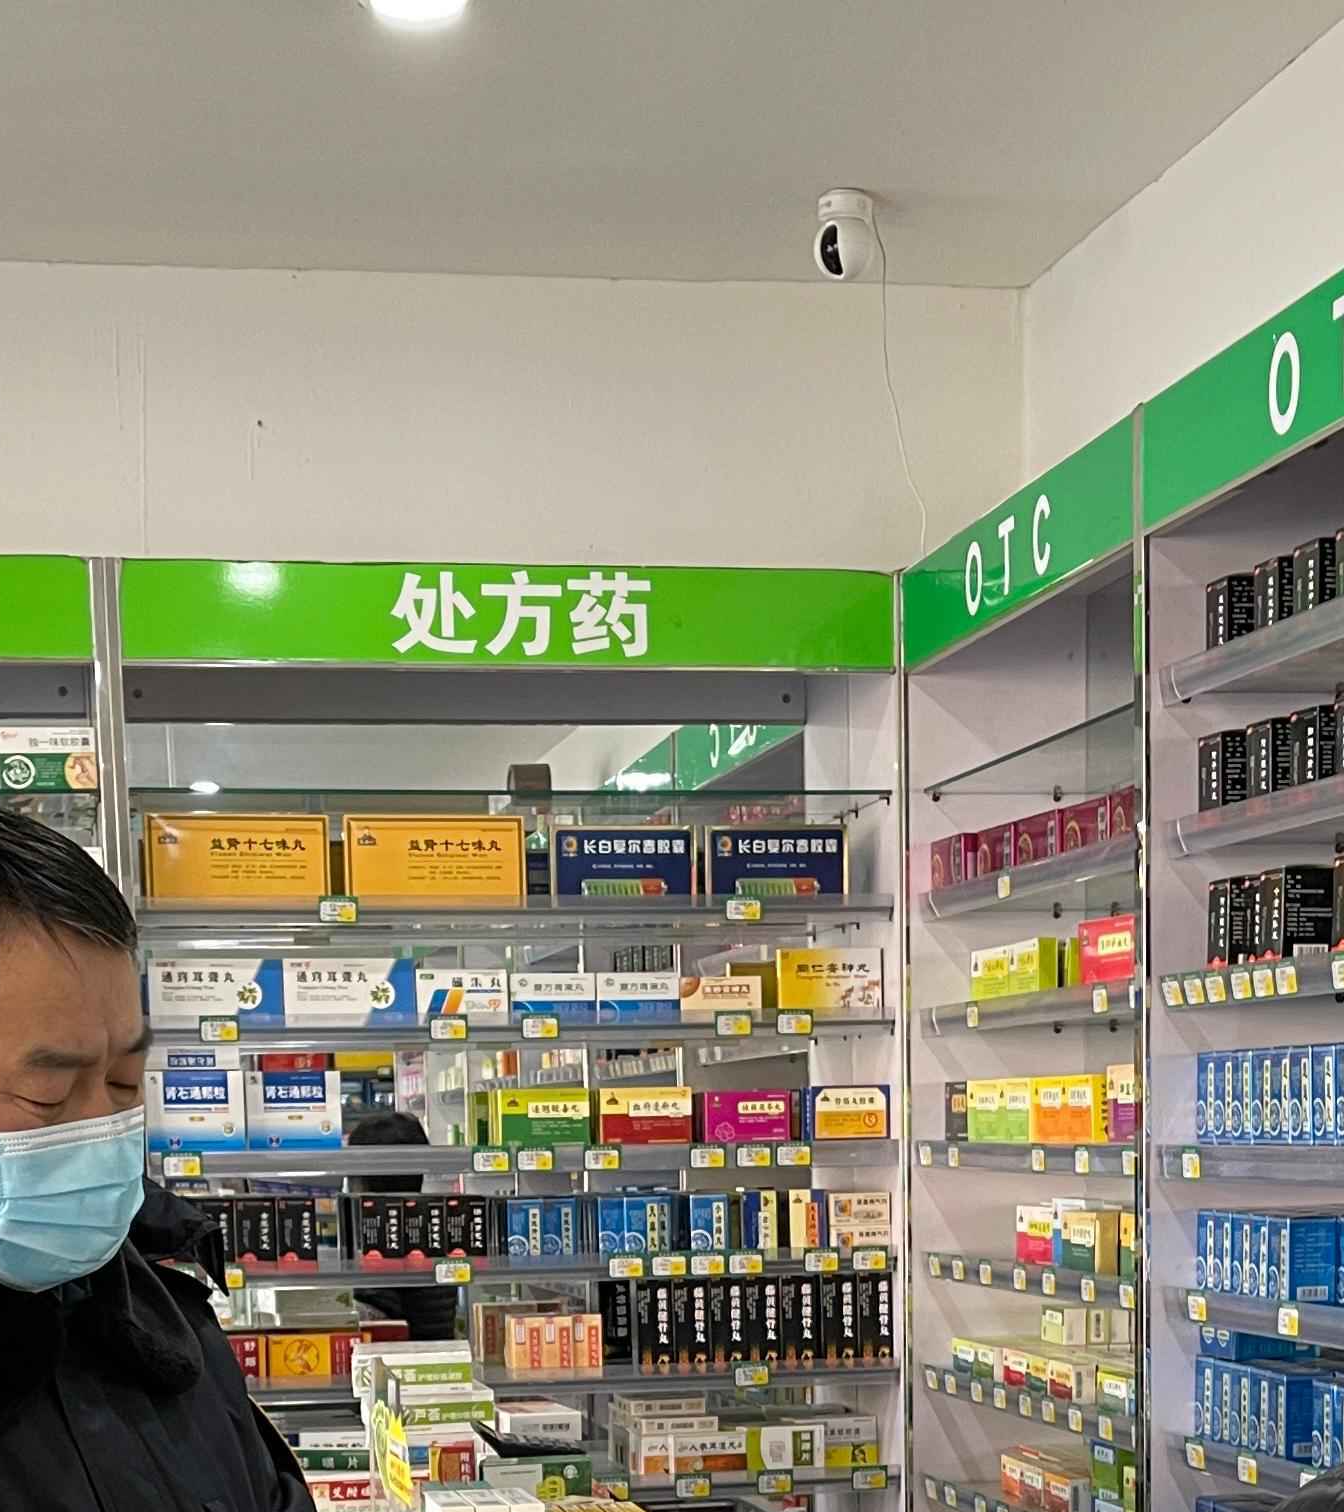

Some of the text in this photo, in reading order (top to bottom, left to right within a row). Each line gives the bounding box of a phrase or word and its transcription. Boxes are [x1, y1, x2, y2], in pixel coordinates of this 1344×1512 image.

[963, 492, 1052, 618] OTC
[390, 570, 652, 659] 处方药
[209, 837, 306, 852] 益肾十七味丸
[407, 838, 502, 852] 益肾十七味丸
